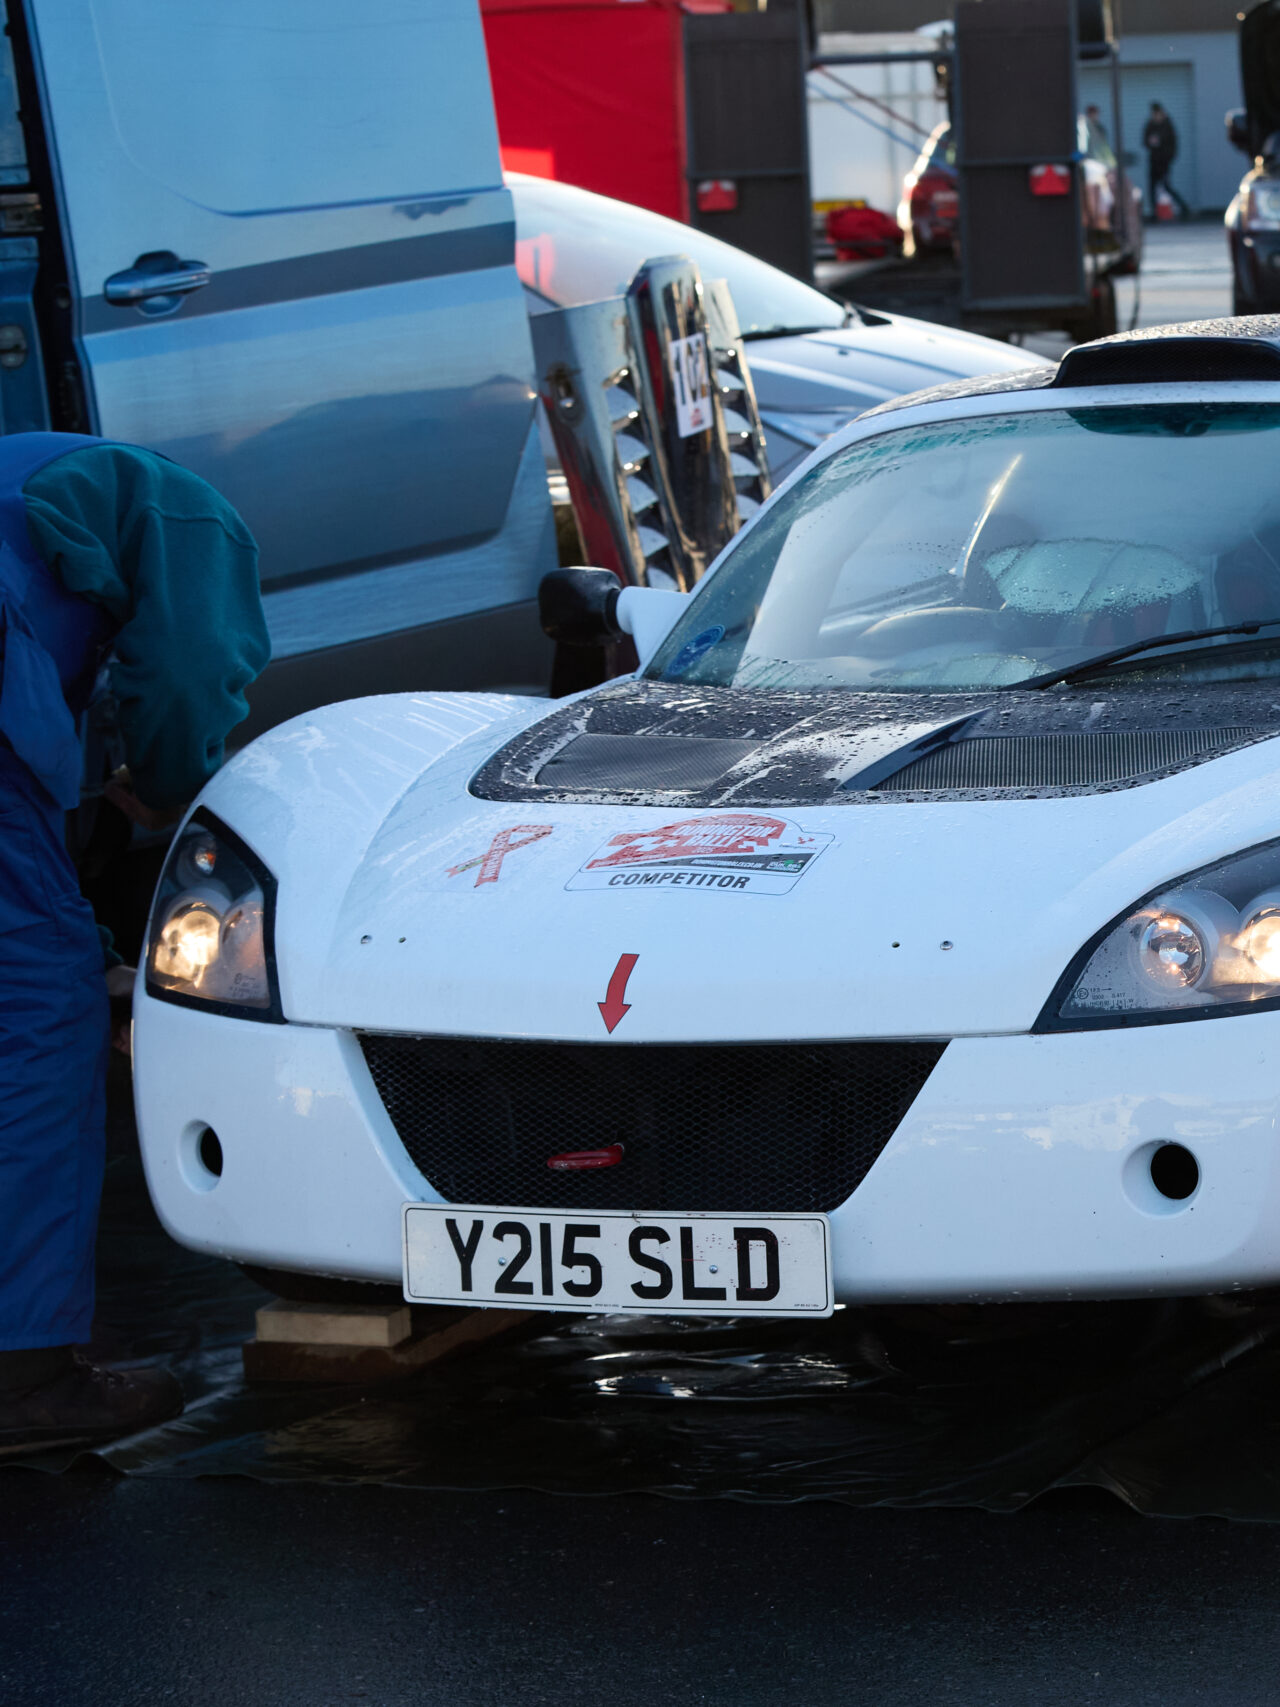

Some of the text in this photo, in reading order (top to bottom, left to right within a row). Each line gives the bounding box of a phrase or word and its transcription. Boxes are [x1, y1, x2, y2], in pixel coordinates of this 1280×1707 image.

[672, 824, 778, 838] DONINGTON
[607, 872, 751, 889] COMPETITOR
[445, 1218, 781, 1301] Y215 SLD
